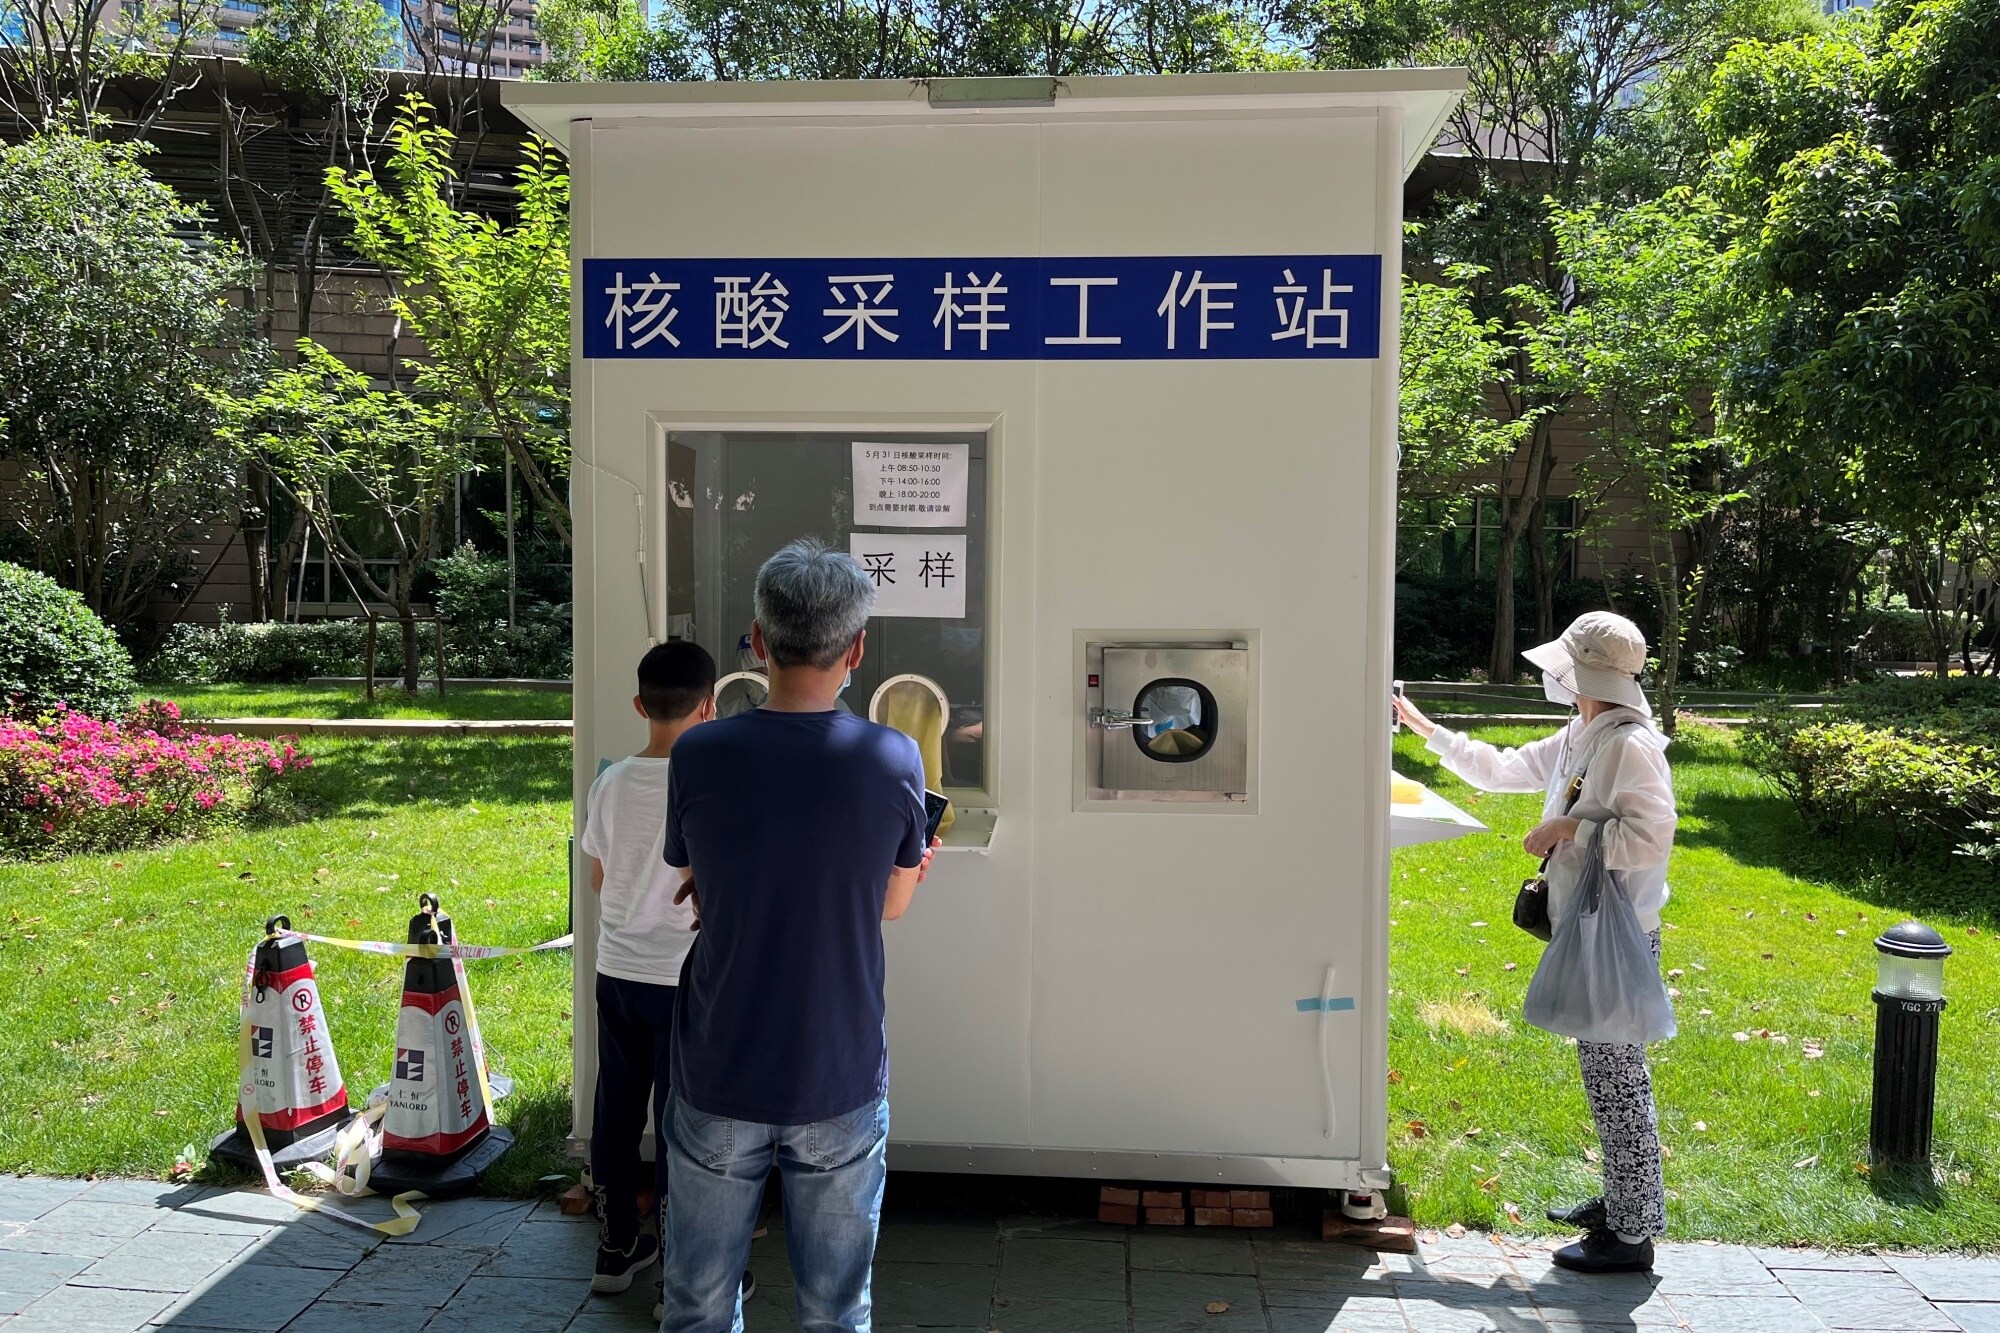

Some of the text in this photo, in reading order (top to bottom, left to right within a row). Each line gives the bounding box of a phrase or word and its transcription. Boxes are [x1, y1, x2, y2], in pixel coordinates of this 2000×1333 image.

[604, 268, 1352, 351] 核酸采样工作站
[863, 551, 955, 588] 采样
[1901, 1001, 1920, 1012] YGC
[299, 1014, 327, 1095] 禁止停车
[450, 1036, 472, 1119] 禁止停车
[389, 1100, 428, 1112] YANLORD
